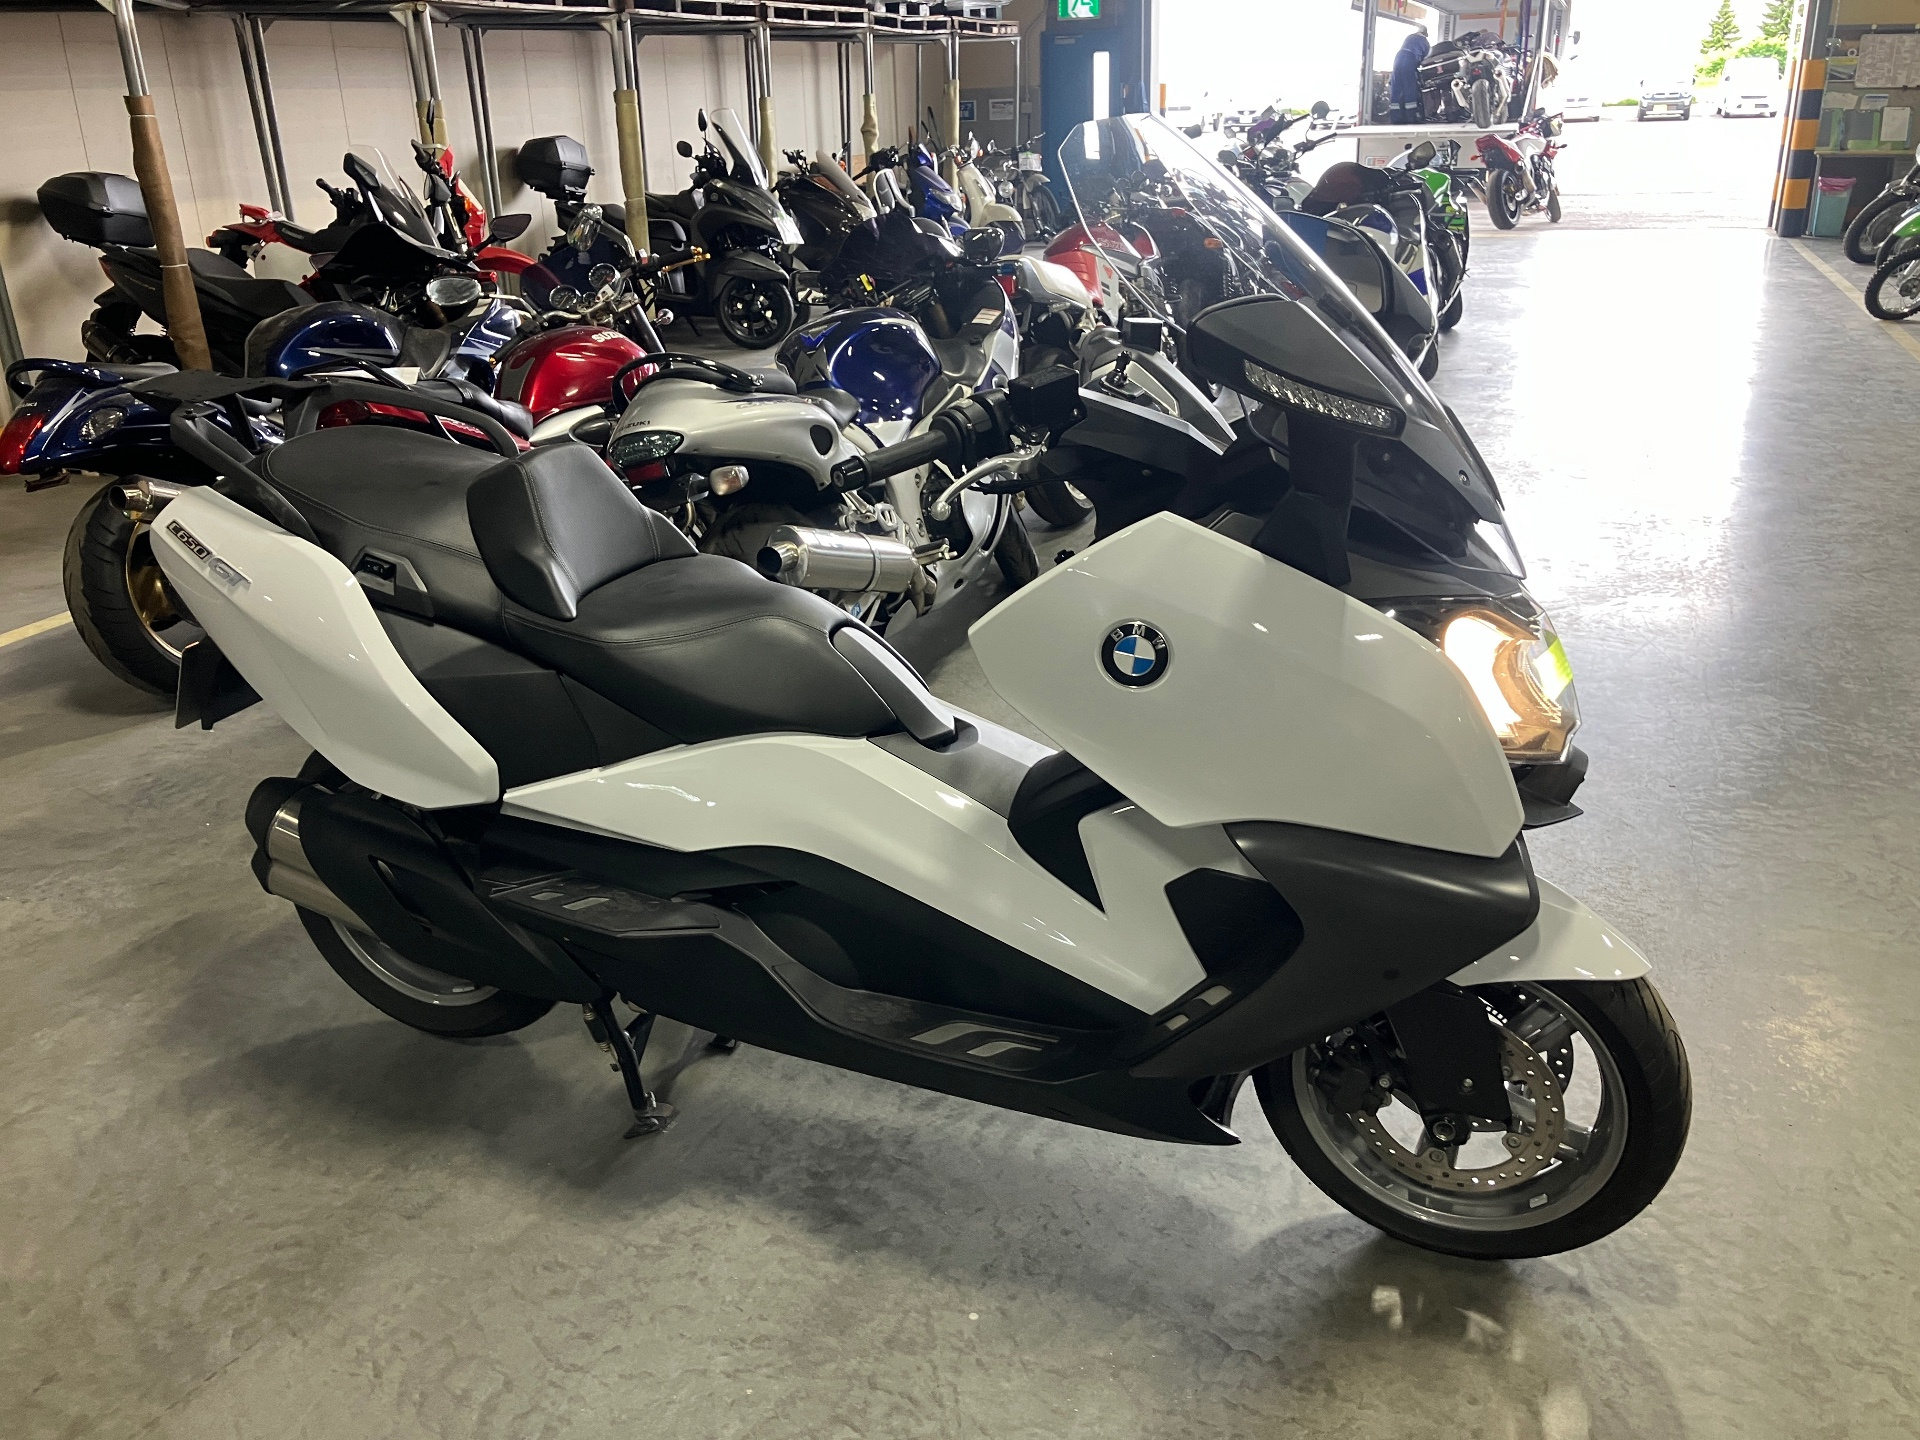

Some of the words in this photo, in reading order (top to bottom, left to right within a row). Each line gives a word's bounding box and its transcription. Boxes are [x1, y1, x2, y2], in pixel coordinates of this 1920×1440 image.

[167, 520, 209, 560] C650
[207, 557, 251, 587] GT
[1110, 622, 1166, 650] BMW
